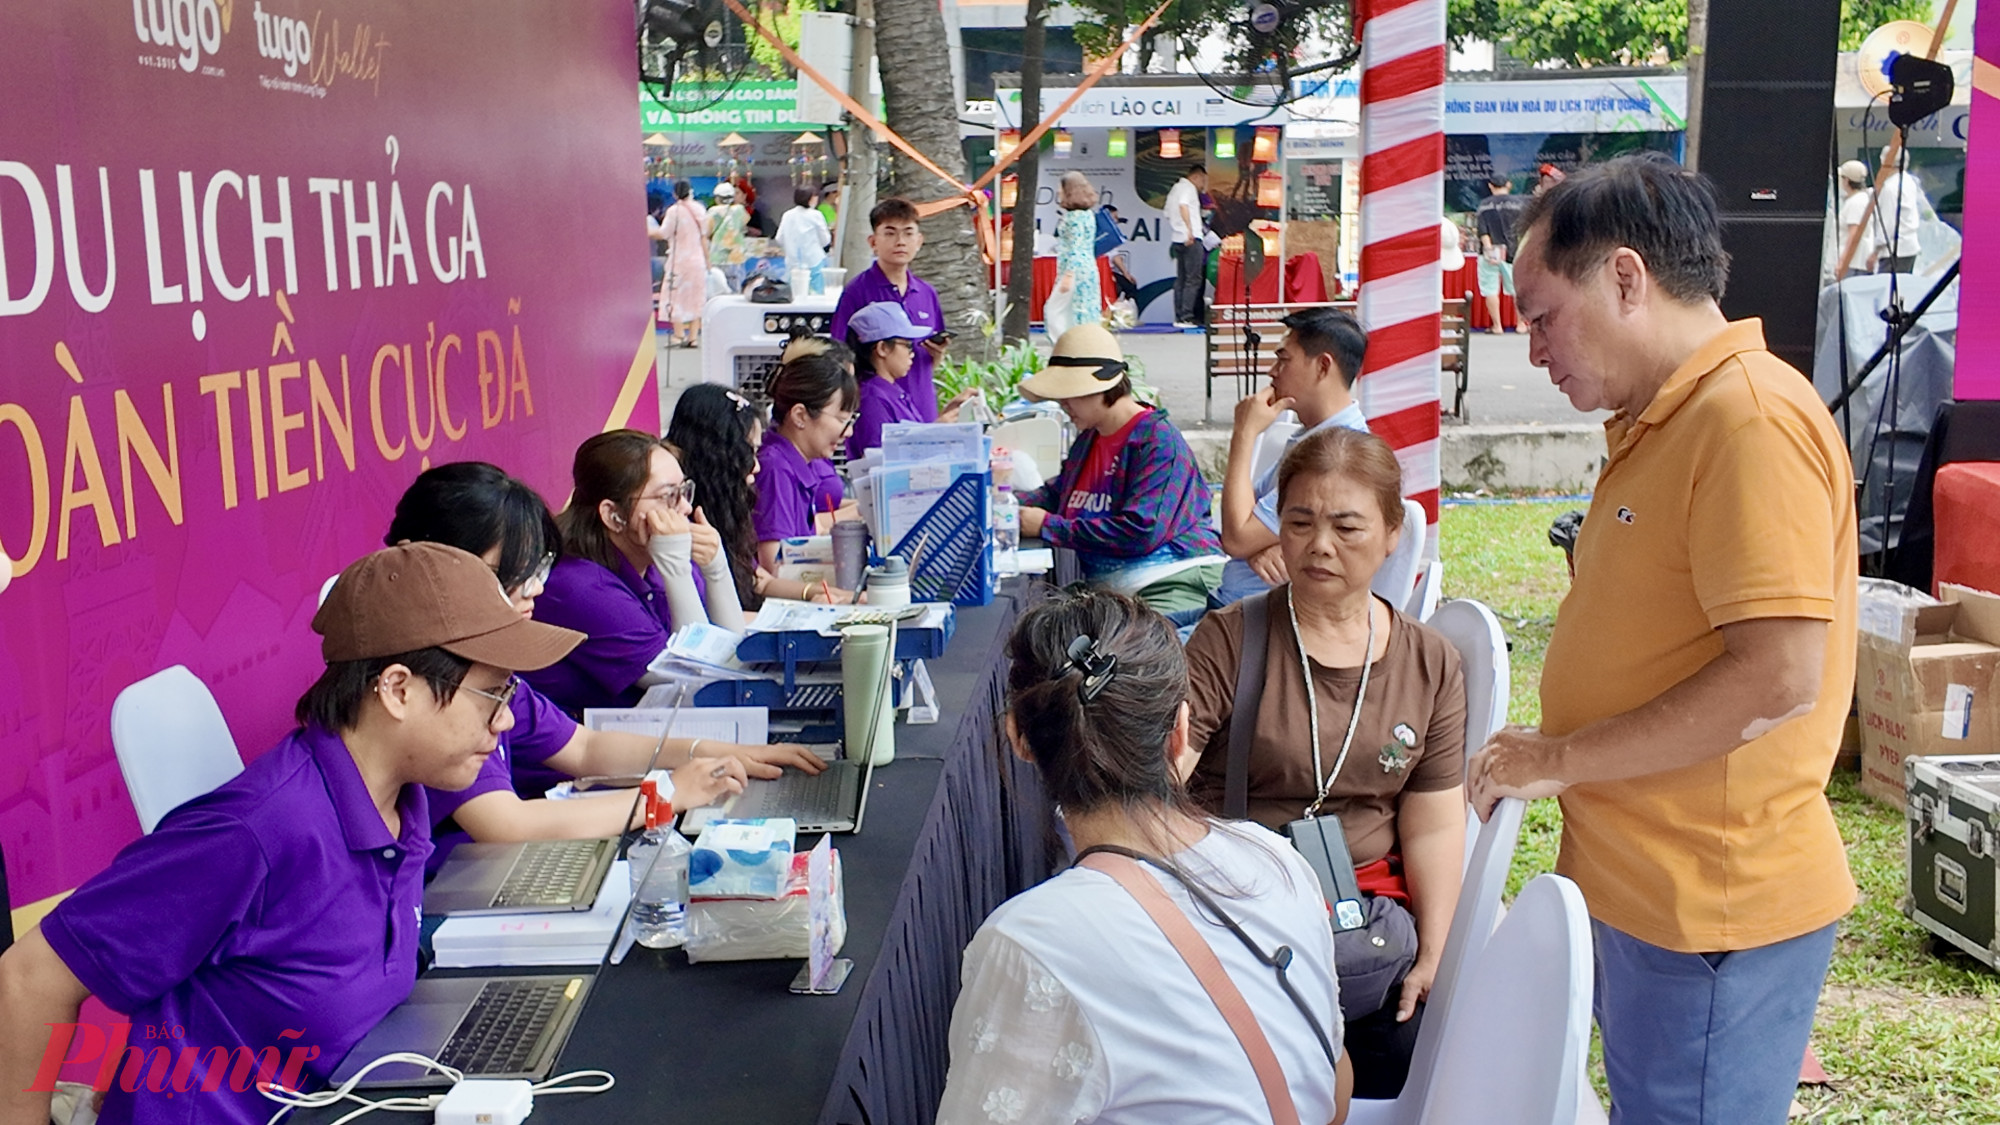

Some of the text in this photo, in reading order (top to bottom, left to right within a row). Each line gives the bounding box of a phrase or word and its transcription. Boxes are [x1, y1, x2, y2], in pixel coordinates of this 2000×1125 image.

[253, 1, 392, 97] tugo Wallet
[736, 89, 764, 100] CAO
[1111, 96, 1146, 115] LÀO
[1152, 100, 1181, 115] CAI
[1445, 98, 1471, 113] HÔNG
[1474, 101, 1497, 113] GIAN
[1544, 100, 1557, 113] DU
[1559, 99, 1581, 114] LỊCH
[744, 109, 773, 124] TIN
[0, 135, 487, 342] DU LỊCH THẢ GA
[200, 289, 356, 510] TIỀN
[369, 321, 468, 471] CỰC
[477, 297, 535, 430] ĐÃ
